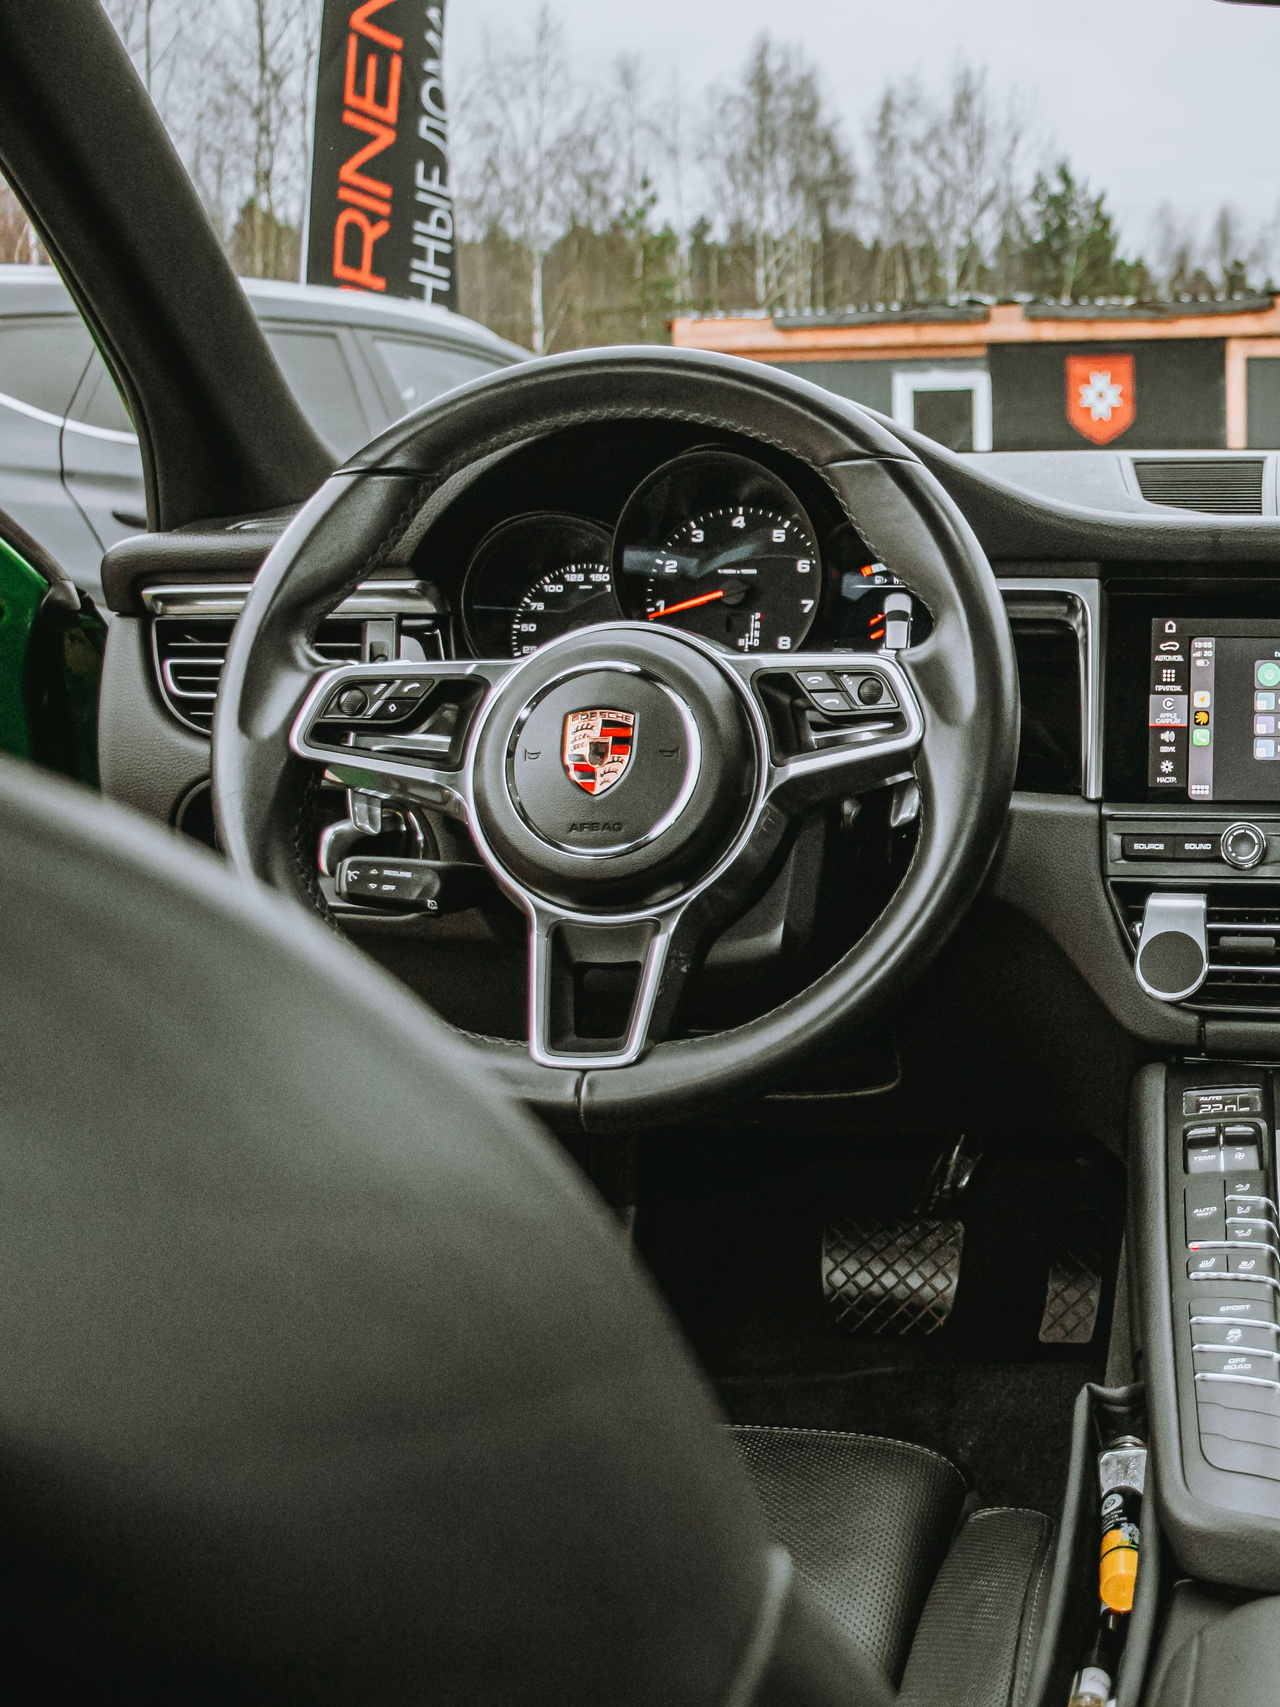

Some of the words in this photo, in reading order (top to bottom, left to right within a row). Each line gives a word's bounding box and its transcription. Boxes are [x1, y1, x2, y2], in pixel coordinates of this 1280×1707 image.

[731, 516, 746, 529] 4
[691, 529, 704, 543] 3
[772, 529, 786, 542] 5
[664, 560, 678, 573] 2
[796, 560, 811, 573] 6
[564, 573, 585, 582] 125
[589, 573, 610, 582] 150
[543, 584, 564, 593] 100
[530, 602, 545, 611] 75
[655, 599, 666, 612] 1
[801, 599, 815, 613] 7
[521, 623, 537, 632] 50
[777, 636, 791, 650] 8
[1194, 641, 1213, 649] 13:55
[522, 645, 538, 654] 25
[571, 711, 632, 722] PORSCHE
[569, 822, 624, 833] AIRBAG
[1220, 1304, 1251, 1312] SPORT
